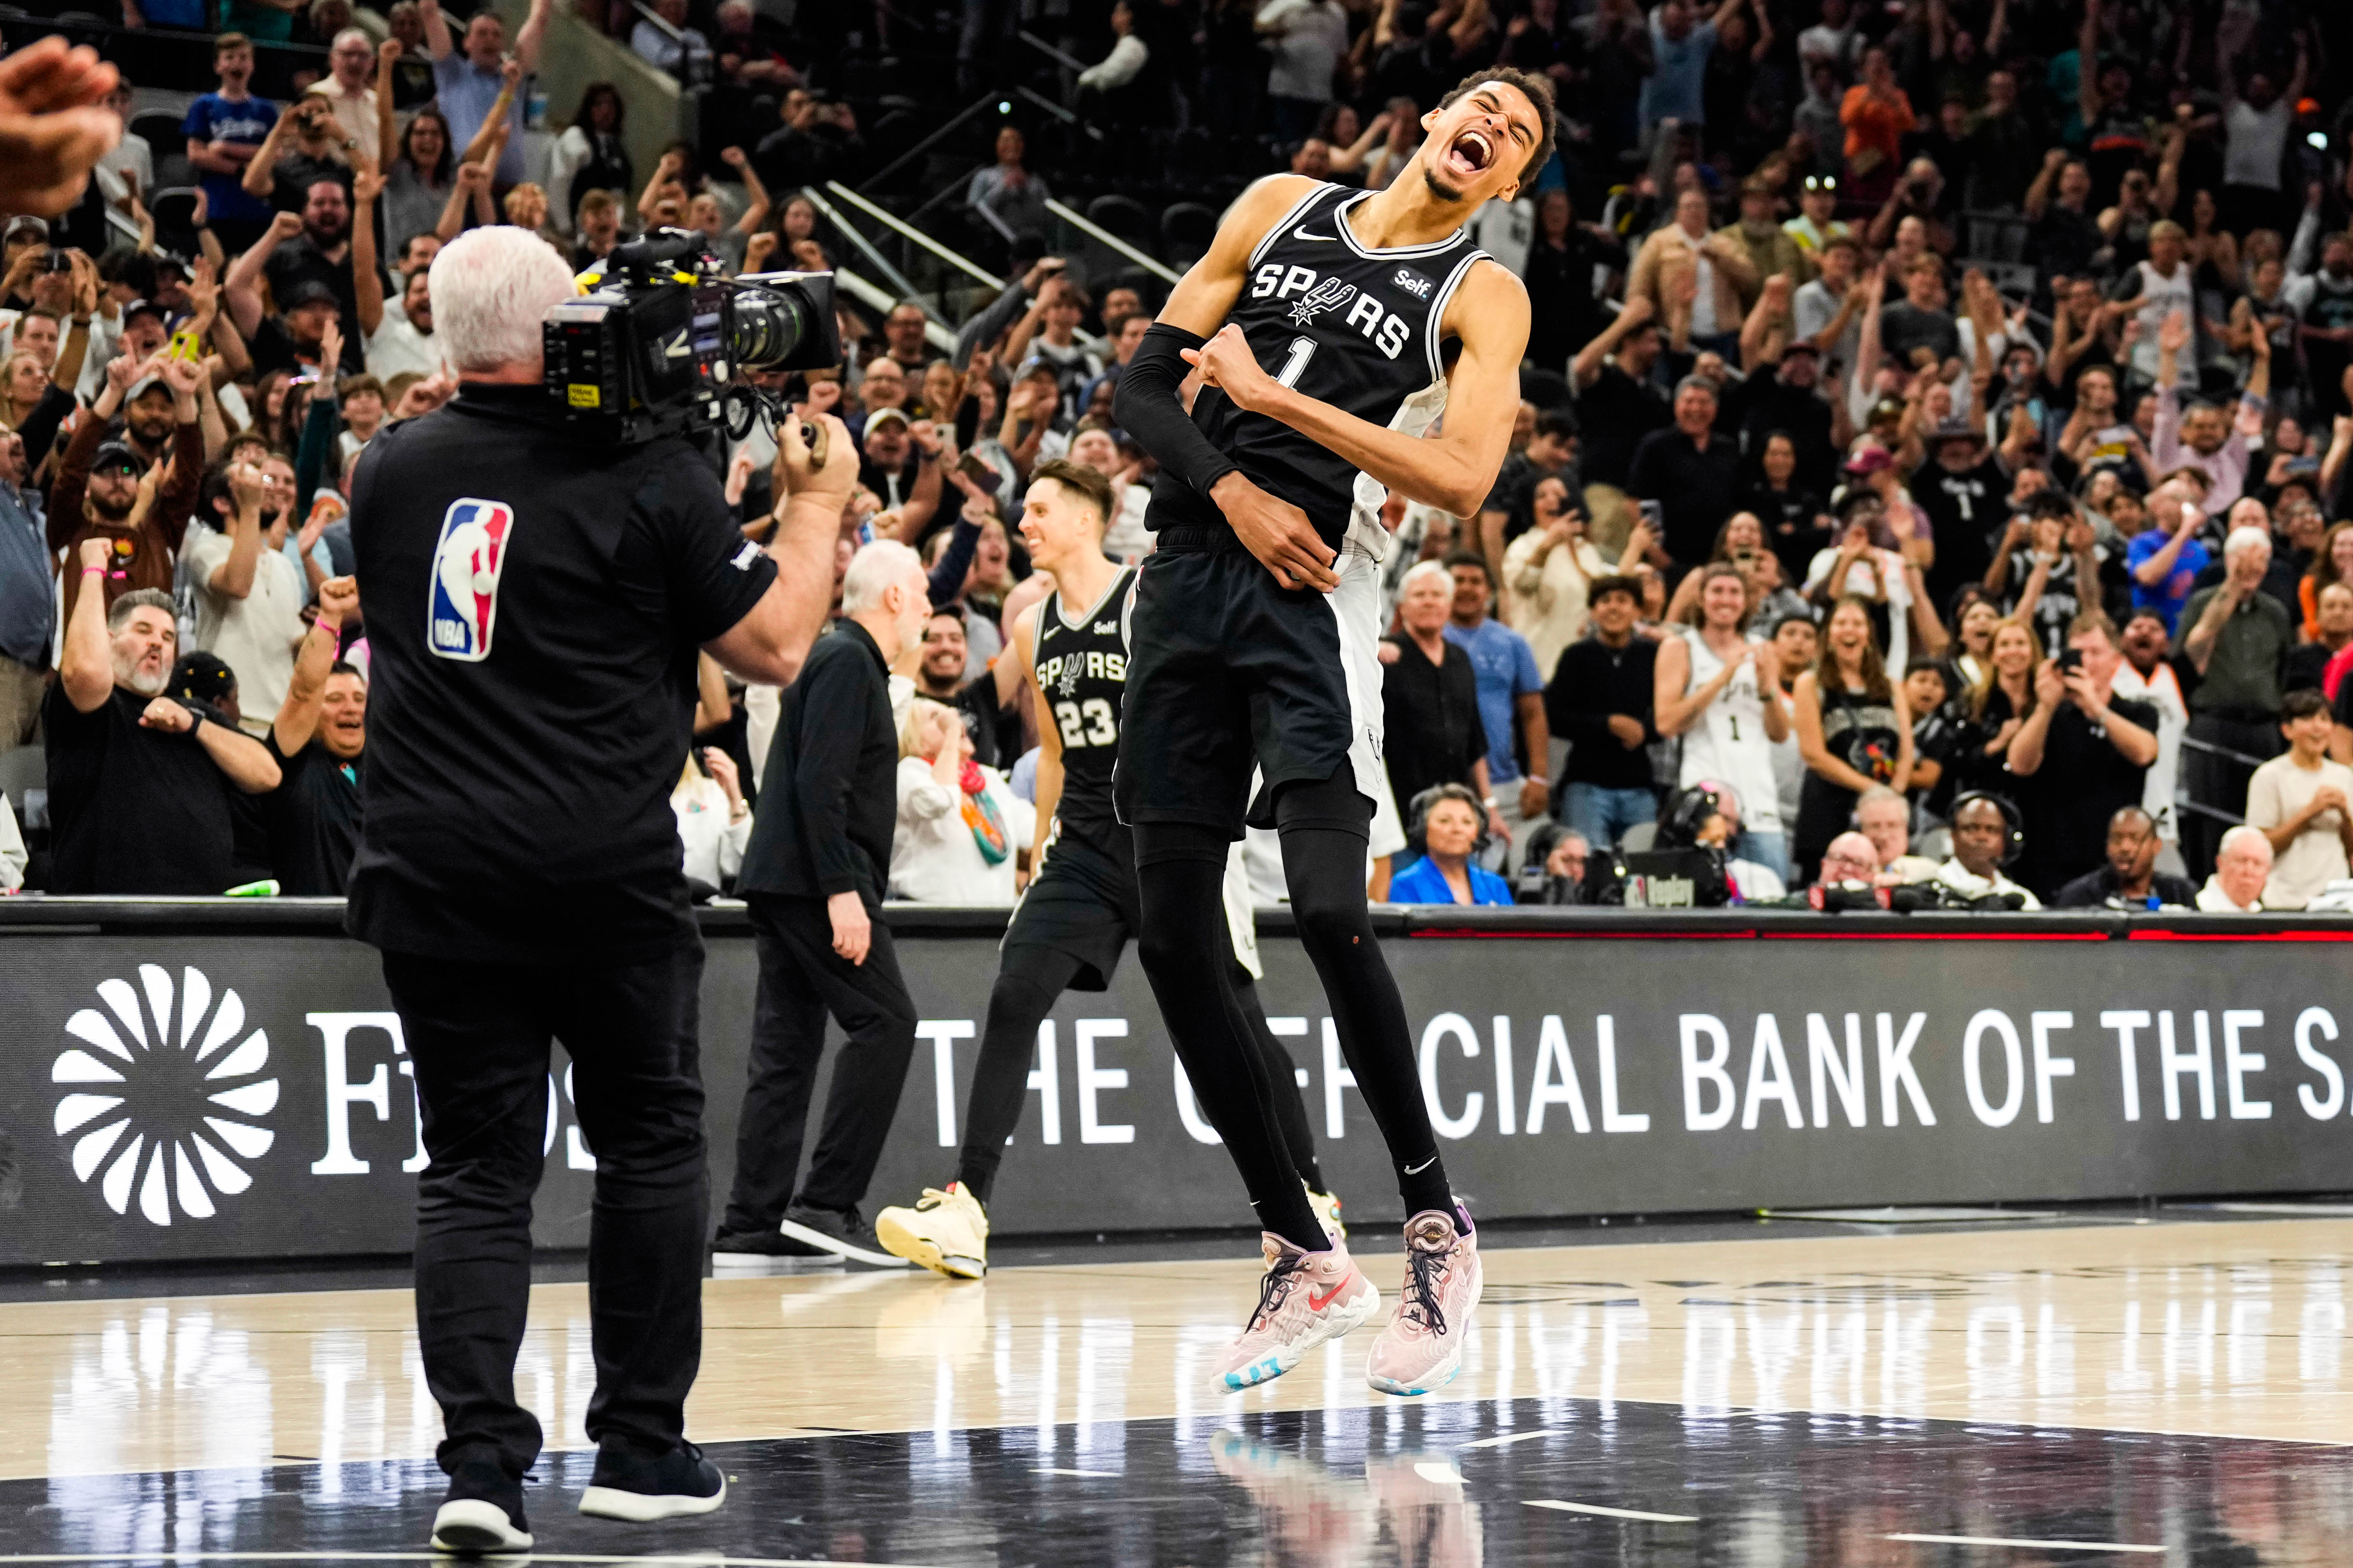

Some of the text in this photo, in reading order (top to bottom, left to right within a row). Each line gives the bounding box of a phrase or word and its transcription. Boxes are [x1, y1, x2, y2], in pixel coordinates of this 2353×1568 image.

[1252, 264, 1410, 360] SPURS
[1271, 335, 1318, 392] 1
[435, 618, 466, 649] NBA
[1054, 697, 1117, 749] 23
[1729, 715, 1740, 741] 1
[1174, 1011, 1650, 1146] FICIAL
[1679, 1012, 1938, 1131] BANK
[1963, 1009, 2075, 1128] OF
[2100, 1009, 2273, 1121] THE
[2294, 1005, 2353, 1121] S
